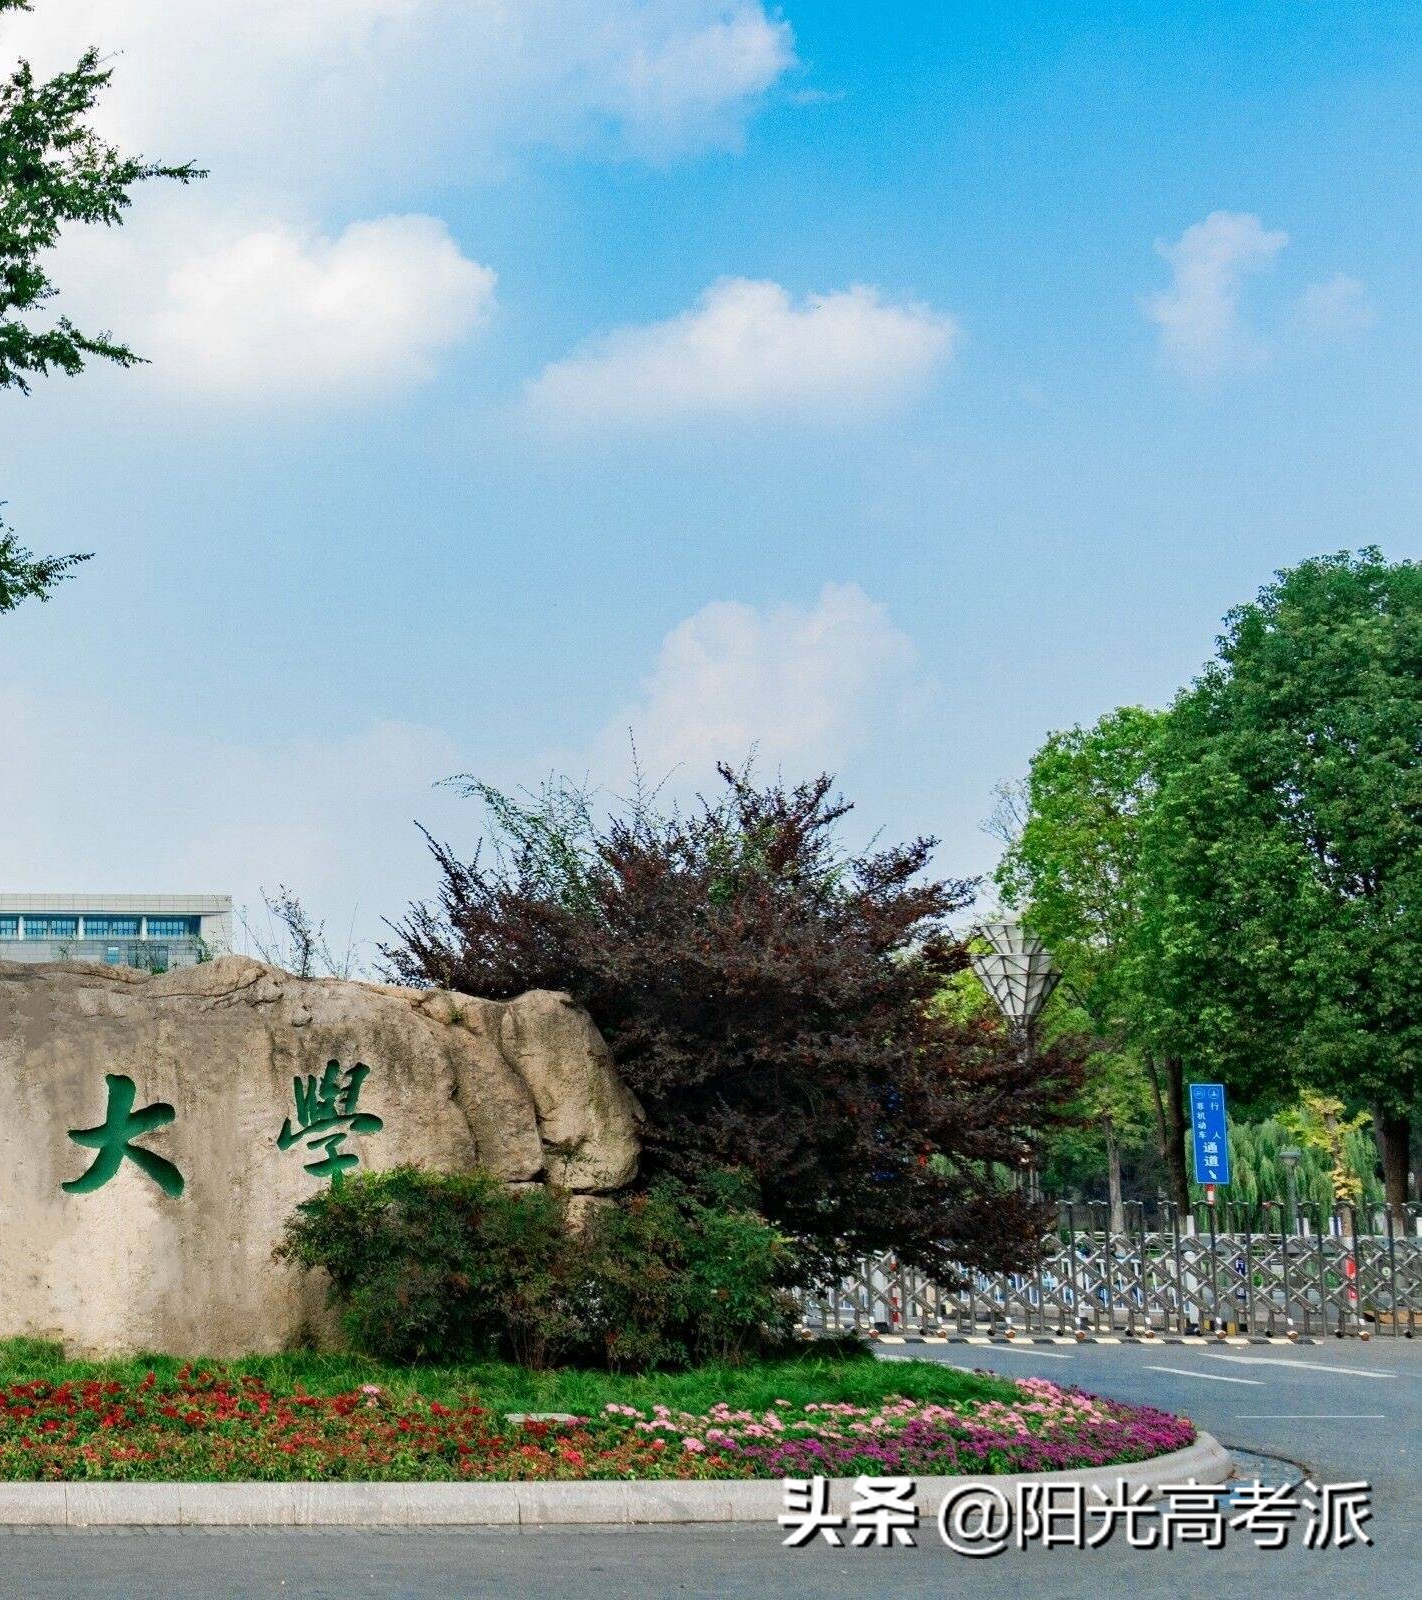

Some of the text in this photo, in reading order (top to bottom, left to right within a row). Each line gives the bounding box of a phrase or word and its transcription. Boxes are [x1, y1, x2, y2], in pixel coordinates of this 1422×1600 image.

[1196, 1102, 1207, 1139] 非机动车
[1210, 1102, 1222, 1139] 行人
[1203, 1142, 1219, 1167] 通道
